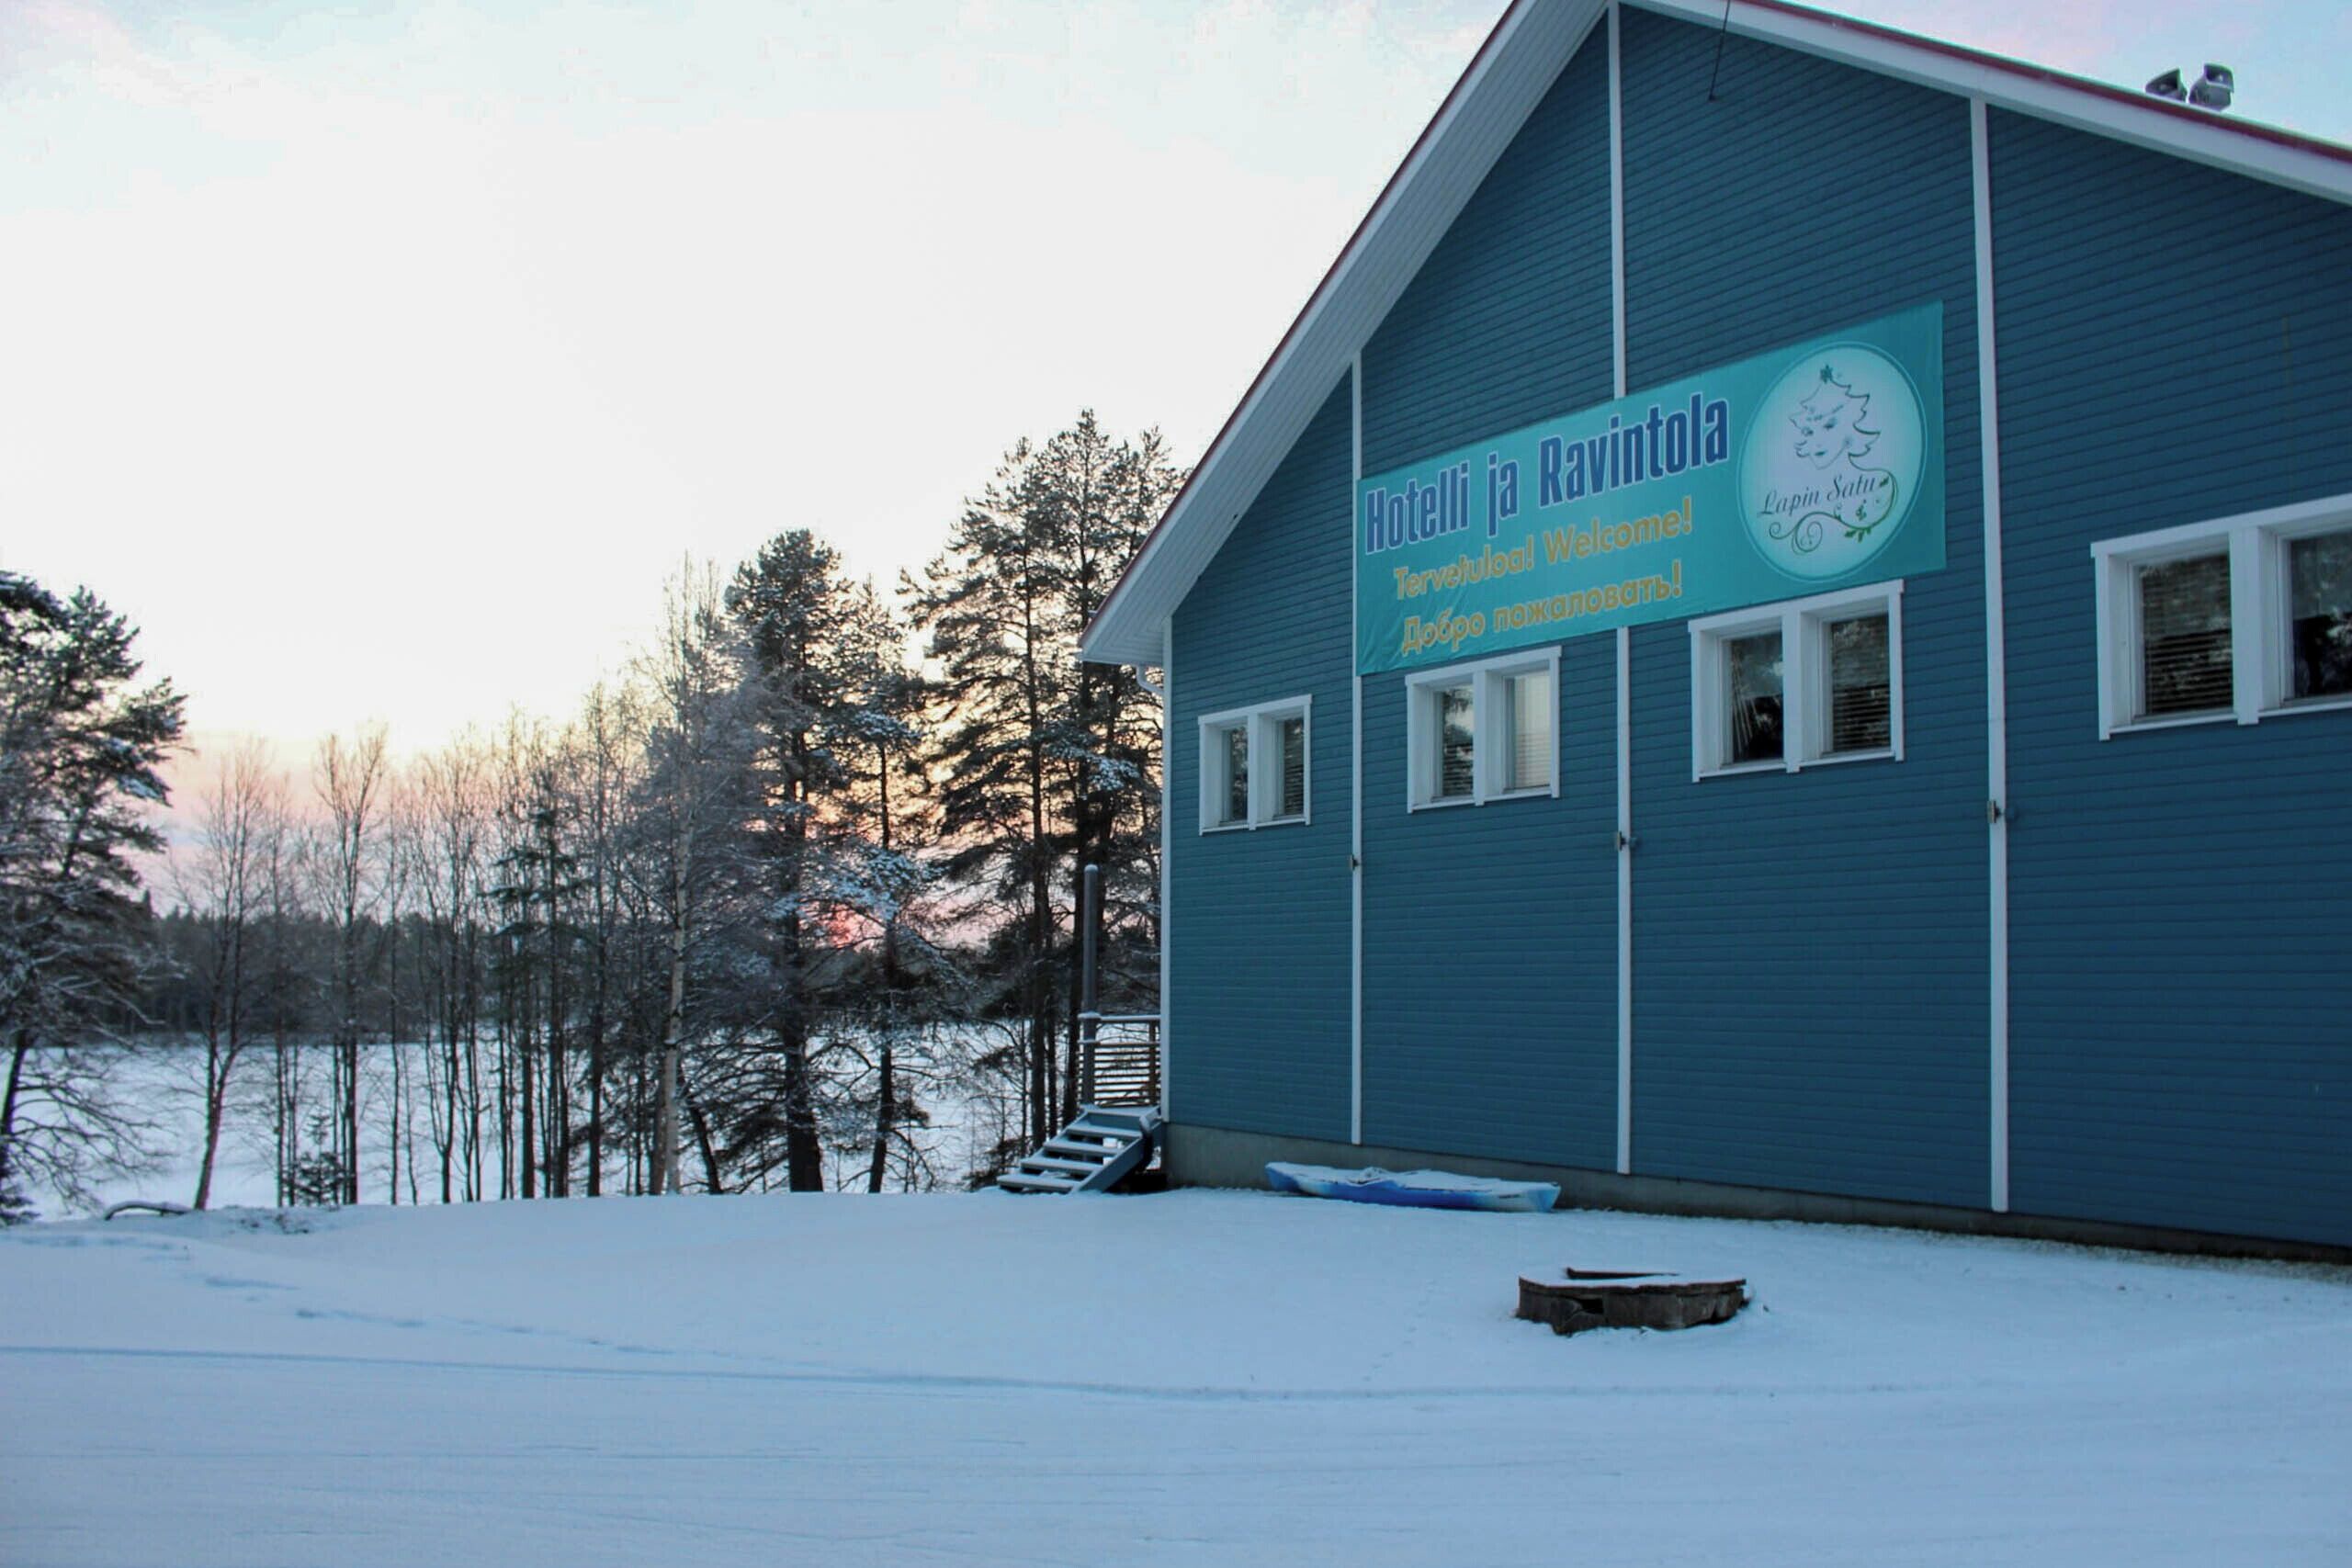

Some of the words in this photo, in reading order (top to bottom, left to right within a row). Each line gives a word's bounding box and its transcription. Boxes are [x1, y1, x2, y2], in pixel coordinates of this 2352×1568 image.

[1365, 461, 1470, 555] Hotelli
[1487, 453, 1520, 538] ja
[1539, 392, 1730, 508] Ravintola
[1757, 487, 1820, 517] Lapin
[1826, 473, 1876, 502] Satu
[1394, 535, 1534, 600] Tervetuloa!
[1544, 495, 1692, 565] Welcome!
[1401, 607, 1486, 657] Добро
[1494, 559, 1682, 632] пожаловать!
